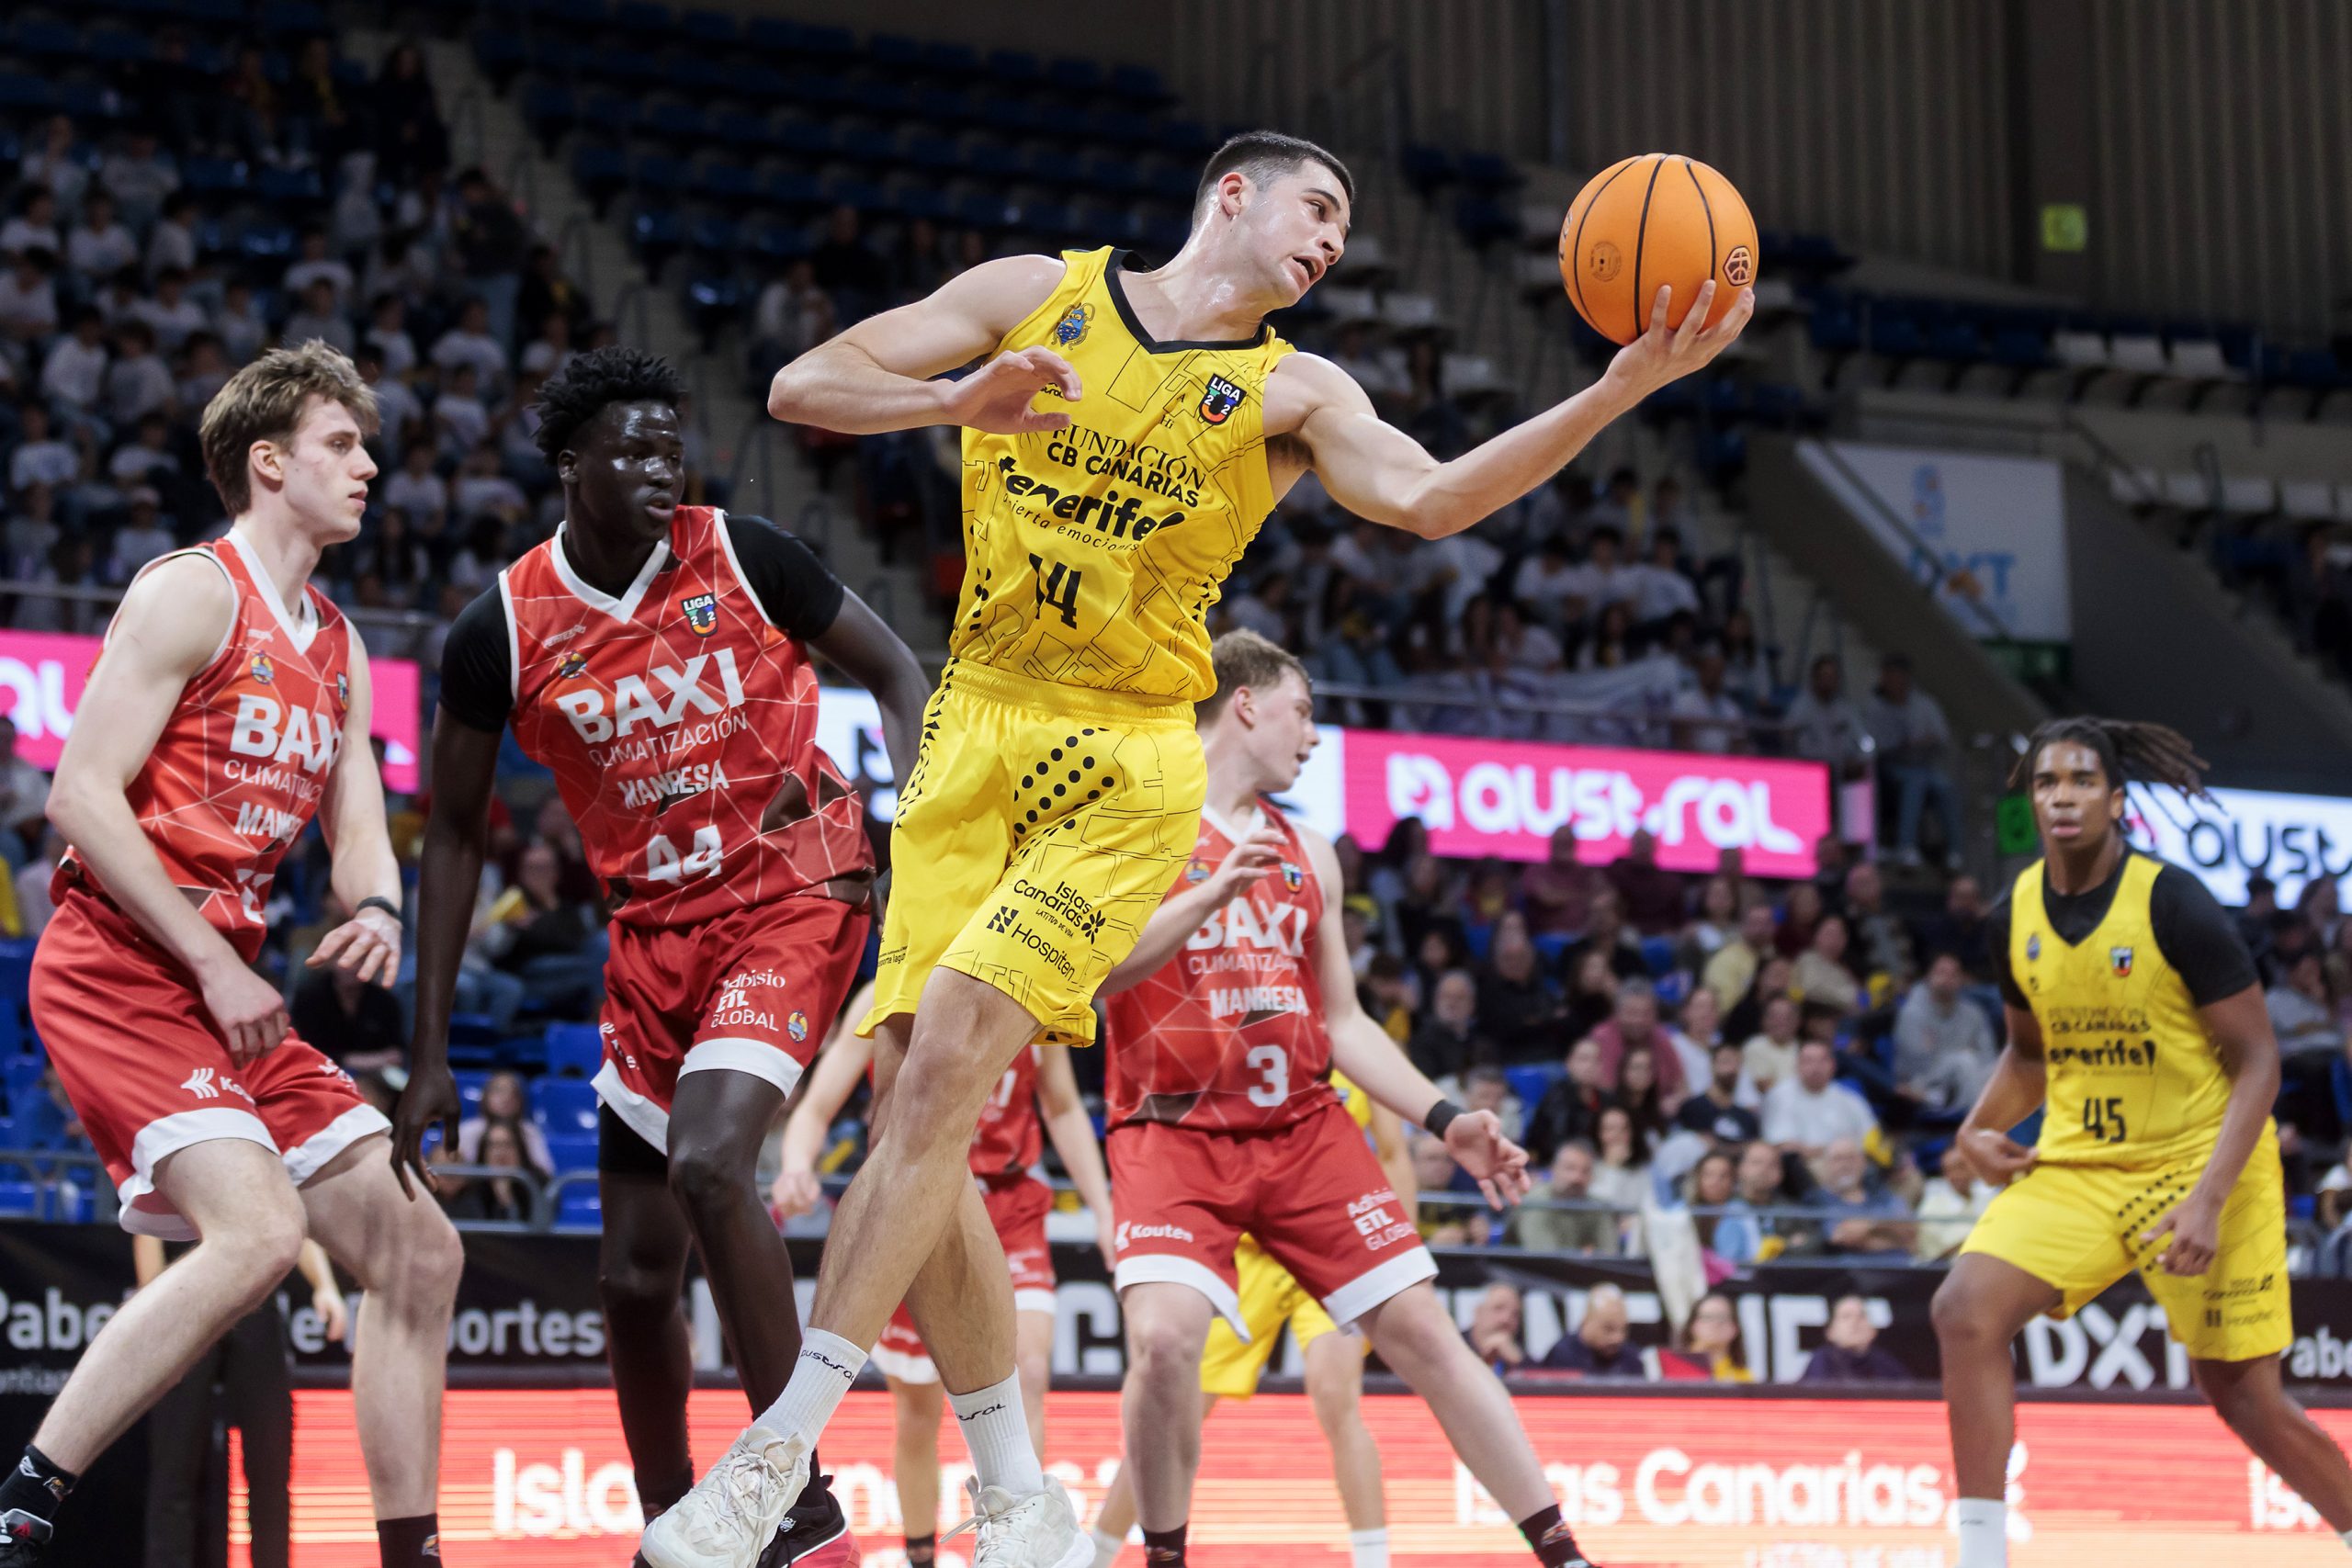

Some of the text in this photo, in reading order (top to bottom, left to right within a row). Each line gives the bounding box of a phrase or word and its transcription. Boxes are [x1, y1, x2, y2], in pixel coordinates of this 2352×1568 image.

[1210, 377, 1240, 401] LIGA
[1046, 442, 1199, 508] CB CANARIAS
[684, 595, 714, 611] LIGA
[1029, 552, 1081, 630] 14
[555, 647, 745, 744] BAXI
[589, 711, 748, 768] CLIMATIZACIÓN
[647, 823, 724, 887] 44
[1013, 879, 1083, 928] Canarias
[1056, 881, 1092, 915] Islas
[1011, 923, 1075, 981] Hospiten
[1186, 897, 1308, 957] BAXI
[710, 1010, 780, 1032] GLOBAL
[716, 988, 750, 1013] ETL
[1209, 985, 1311, 1021] MANRESA
[1246, 1044, 1289, 1108] 3
[2083, 1097, 2128, 1144] 45
[1634, 1445, 1944, 1528] Canarias
